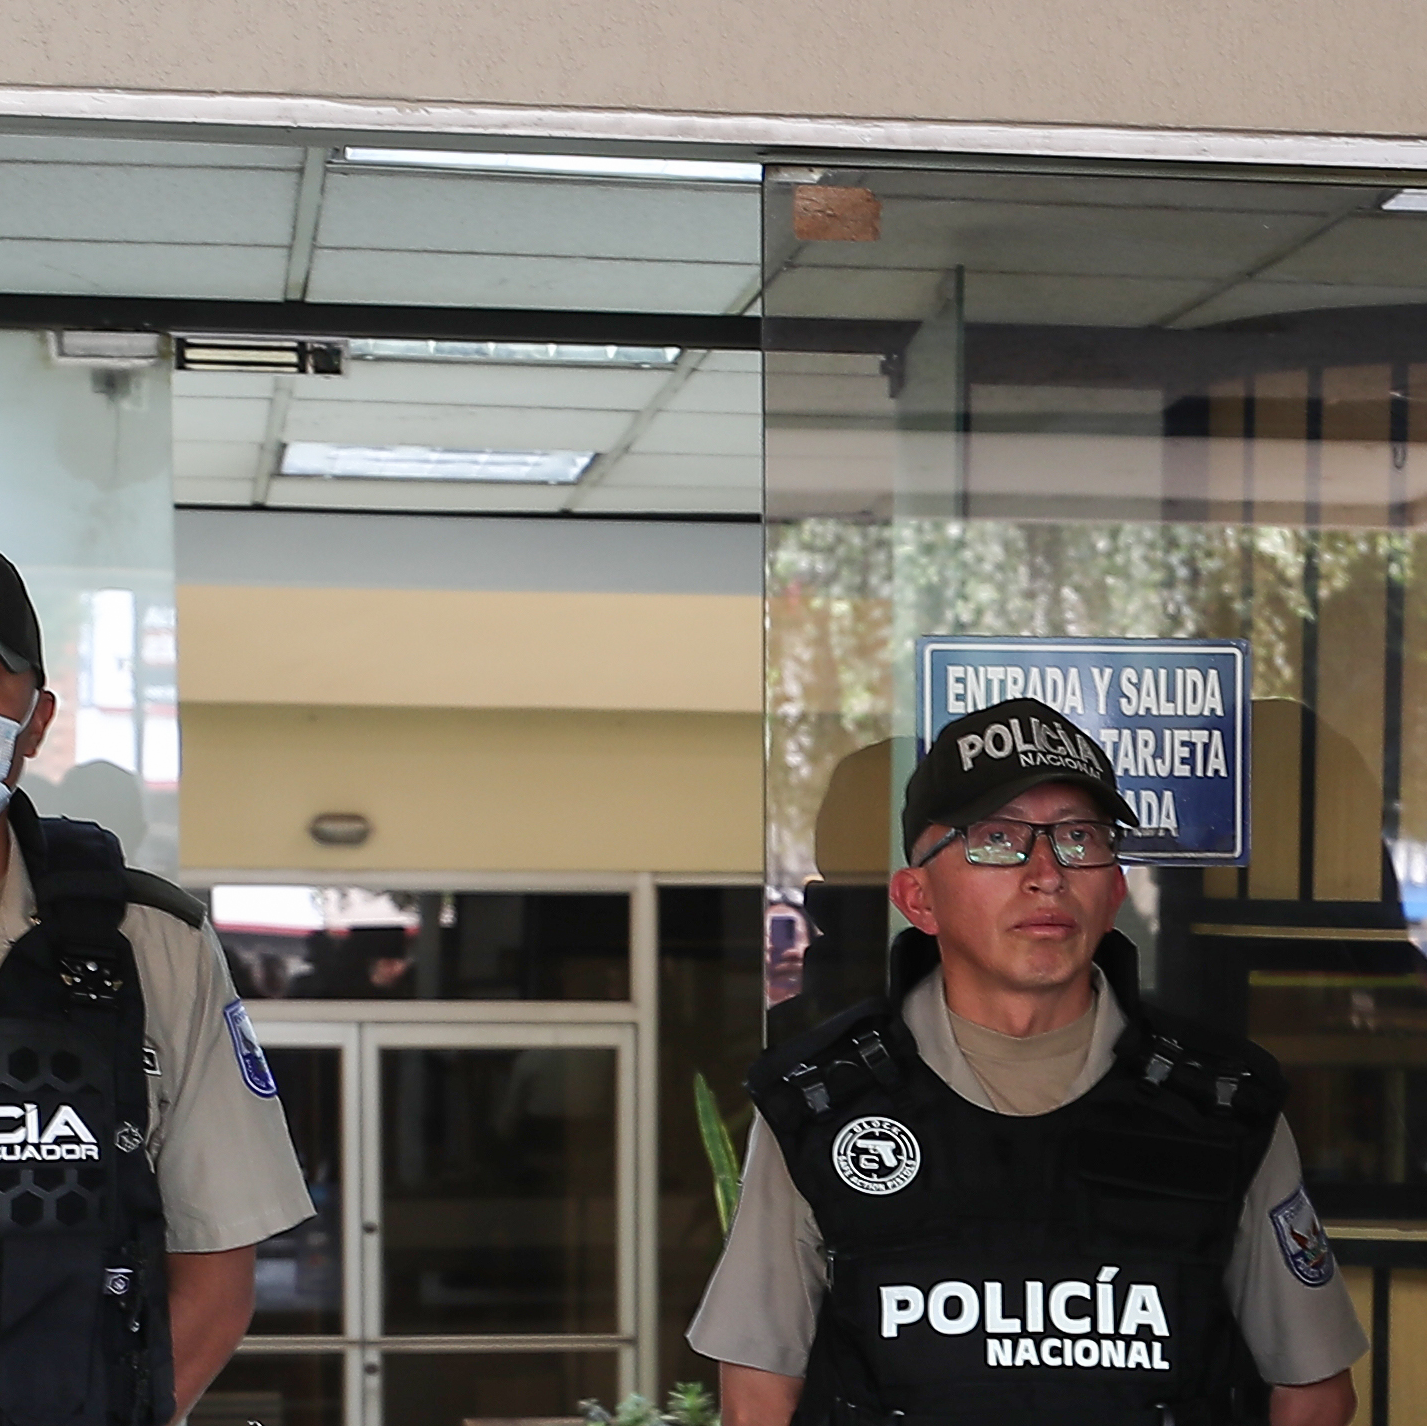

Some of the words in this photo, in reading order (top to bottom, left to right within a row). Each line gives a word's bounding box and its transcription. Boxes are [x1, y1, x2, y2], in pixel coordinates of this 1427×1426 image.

[946, 665, 1084, 715] ENTRADA
[1091, 667, 1113, 714] Y
[1119, 667, 1224, 716] SALIDA
[957, 716, 1103, 772] POLICÍA
[1019, 752, 1101, 781] NACIONAL
[1100, 729, 1228, 777] TARJETA
[879, 1266, 1170, 1338] POLICÍA
[986, 1337, 1170, 1370] NACIONAL
